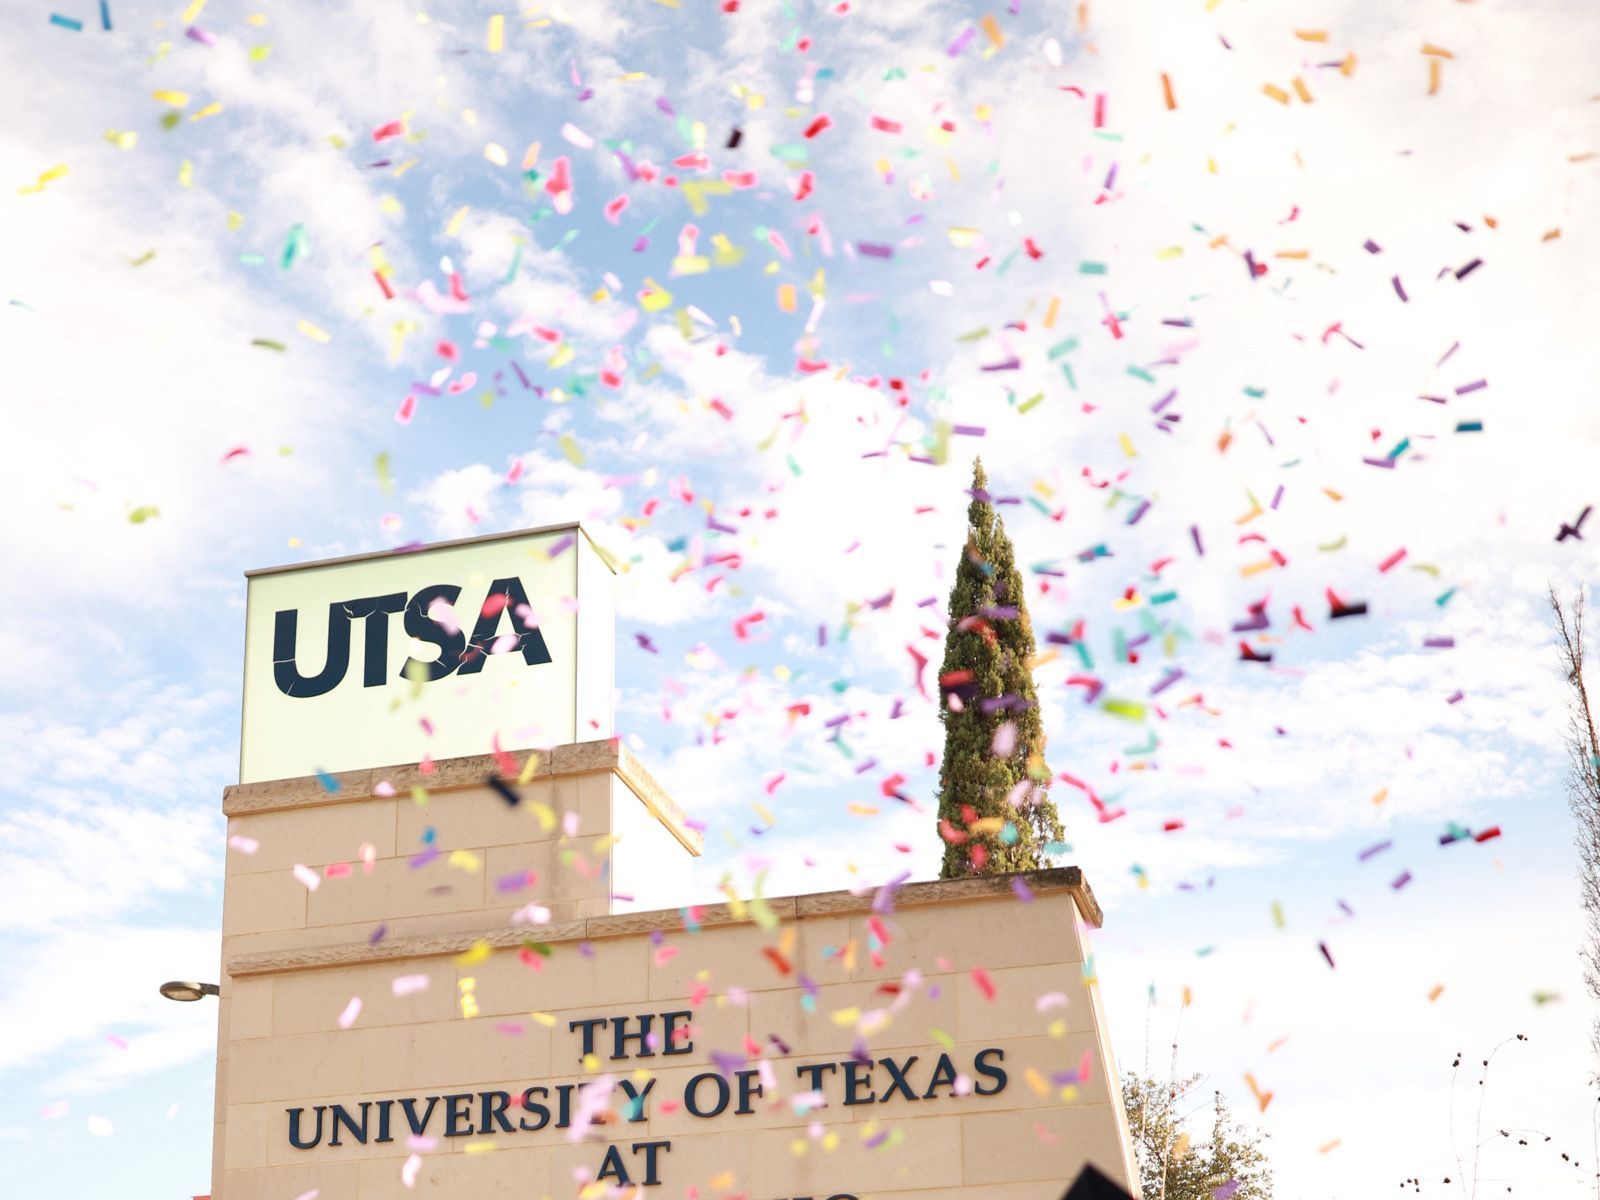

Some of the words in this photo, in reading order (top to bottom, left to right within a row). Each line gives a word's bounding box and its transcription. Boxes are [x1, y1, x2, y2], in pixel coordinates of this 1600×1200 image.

[273, 576, 553, 698] UTSA
[569, 1009, 694, 1063] THE
[286, 1077, 657, 1150] UNIVERSIY
[684, 1071, 766, 1118] OF
[797, 1047, 1009, 1108] TEXAS
[596, 1140, 671, 1188] AT
